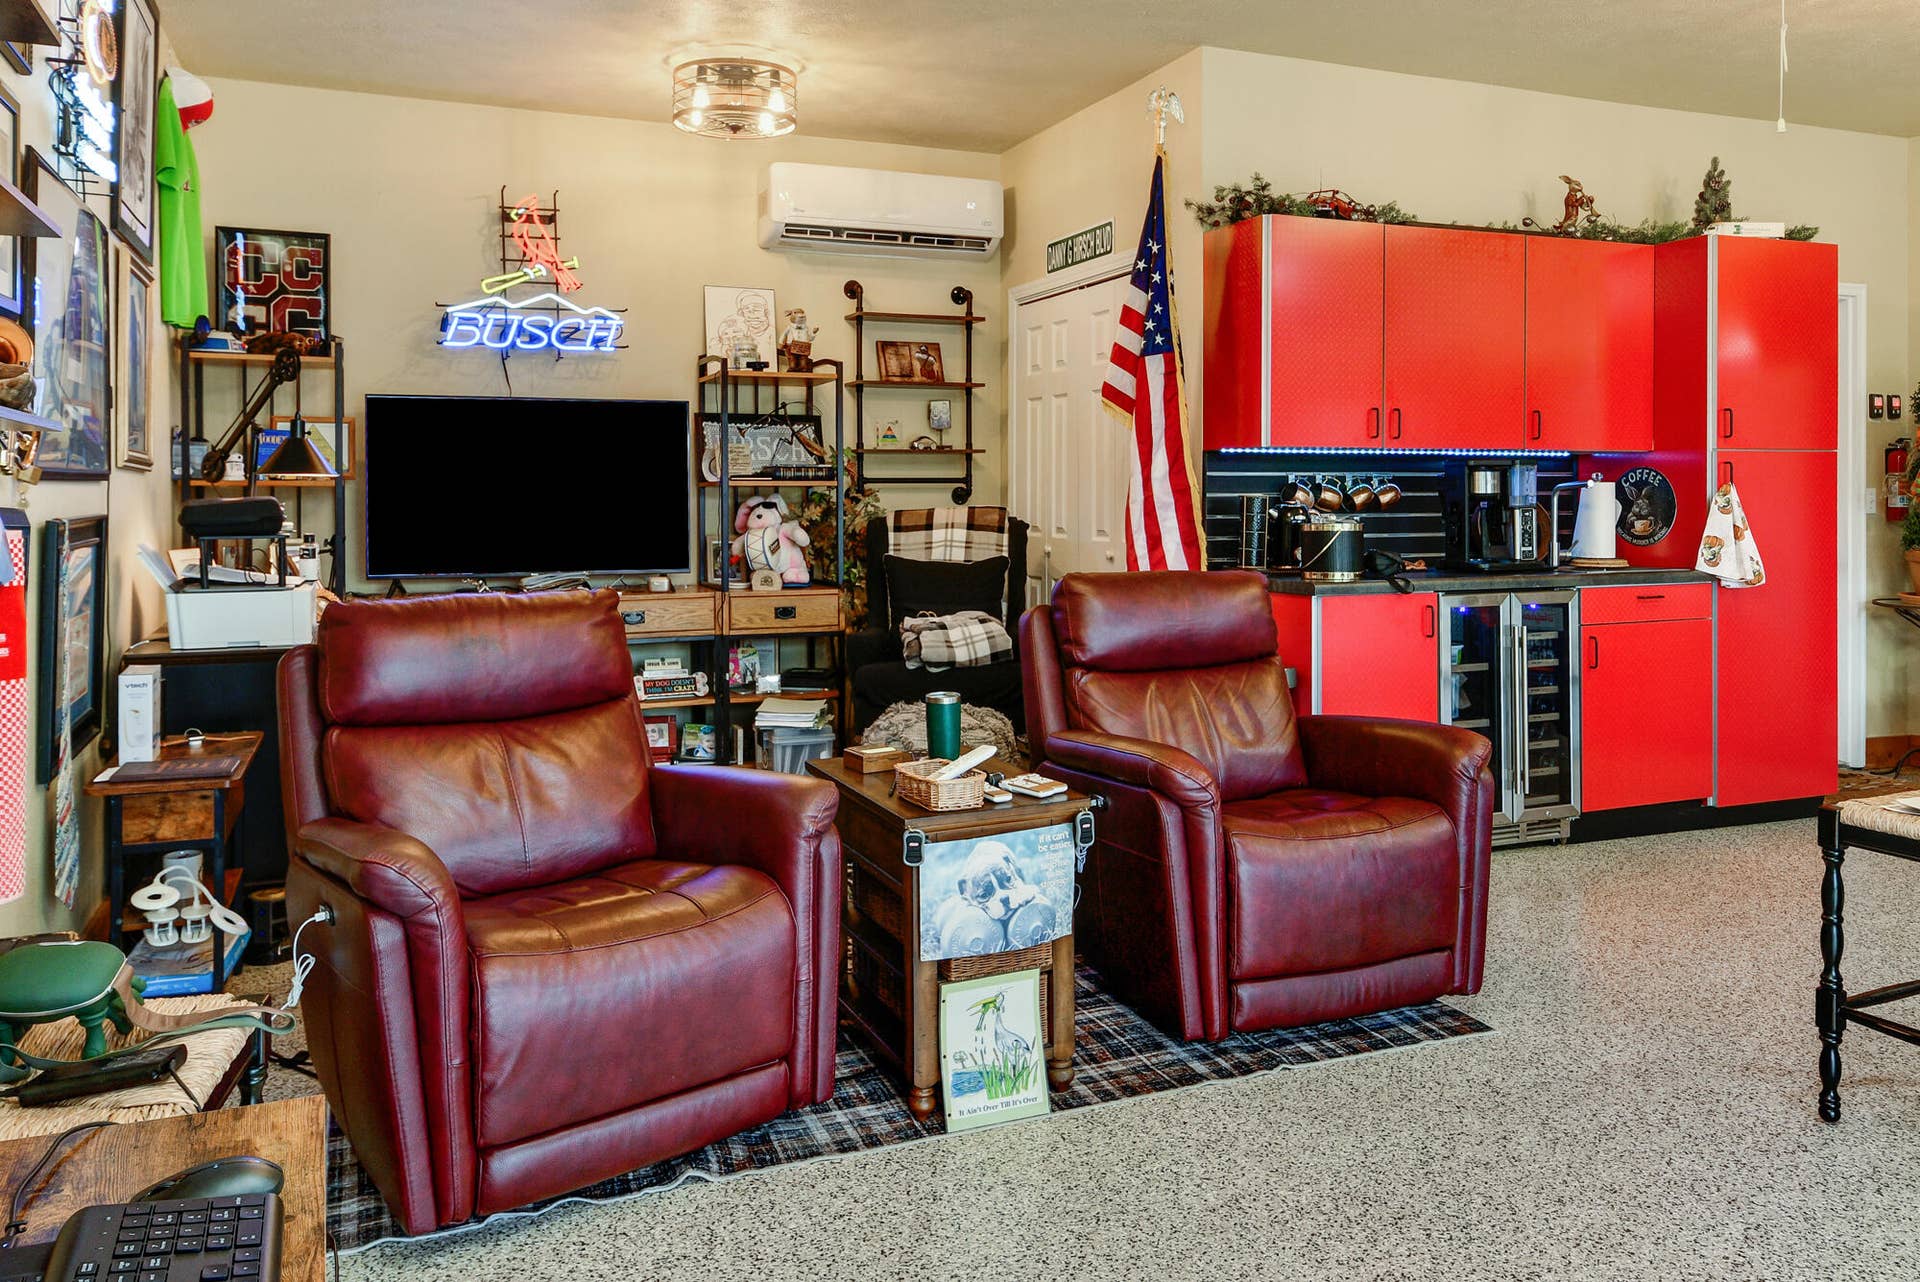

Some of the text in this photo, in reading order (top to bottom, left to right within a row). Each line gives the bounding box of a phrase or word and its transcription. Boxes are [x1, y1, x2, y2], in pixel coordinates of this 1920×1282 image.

[1048, 225, 1112, 271] DANNY G HIRSCH BLVD
[443, 311, 625, 351] BUSCH
[1621, 469, 1662, 487] COFFEE
[1052, 831, 1069, 841] can't
[966, 1106, 981, 1115] Ain't
[983, 1104, 998, 1112] Over
[1000, 1101, 1011, 1109] Till
[1023, 1096, 1038, 1104] Over
